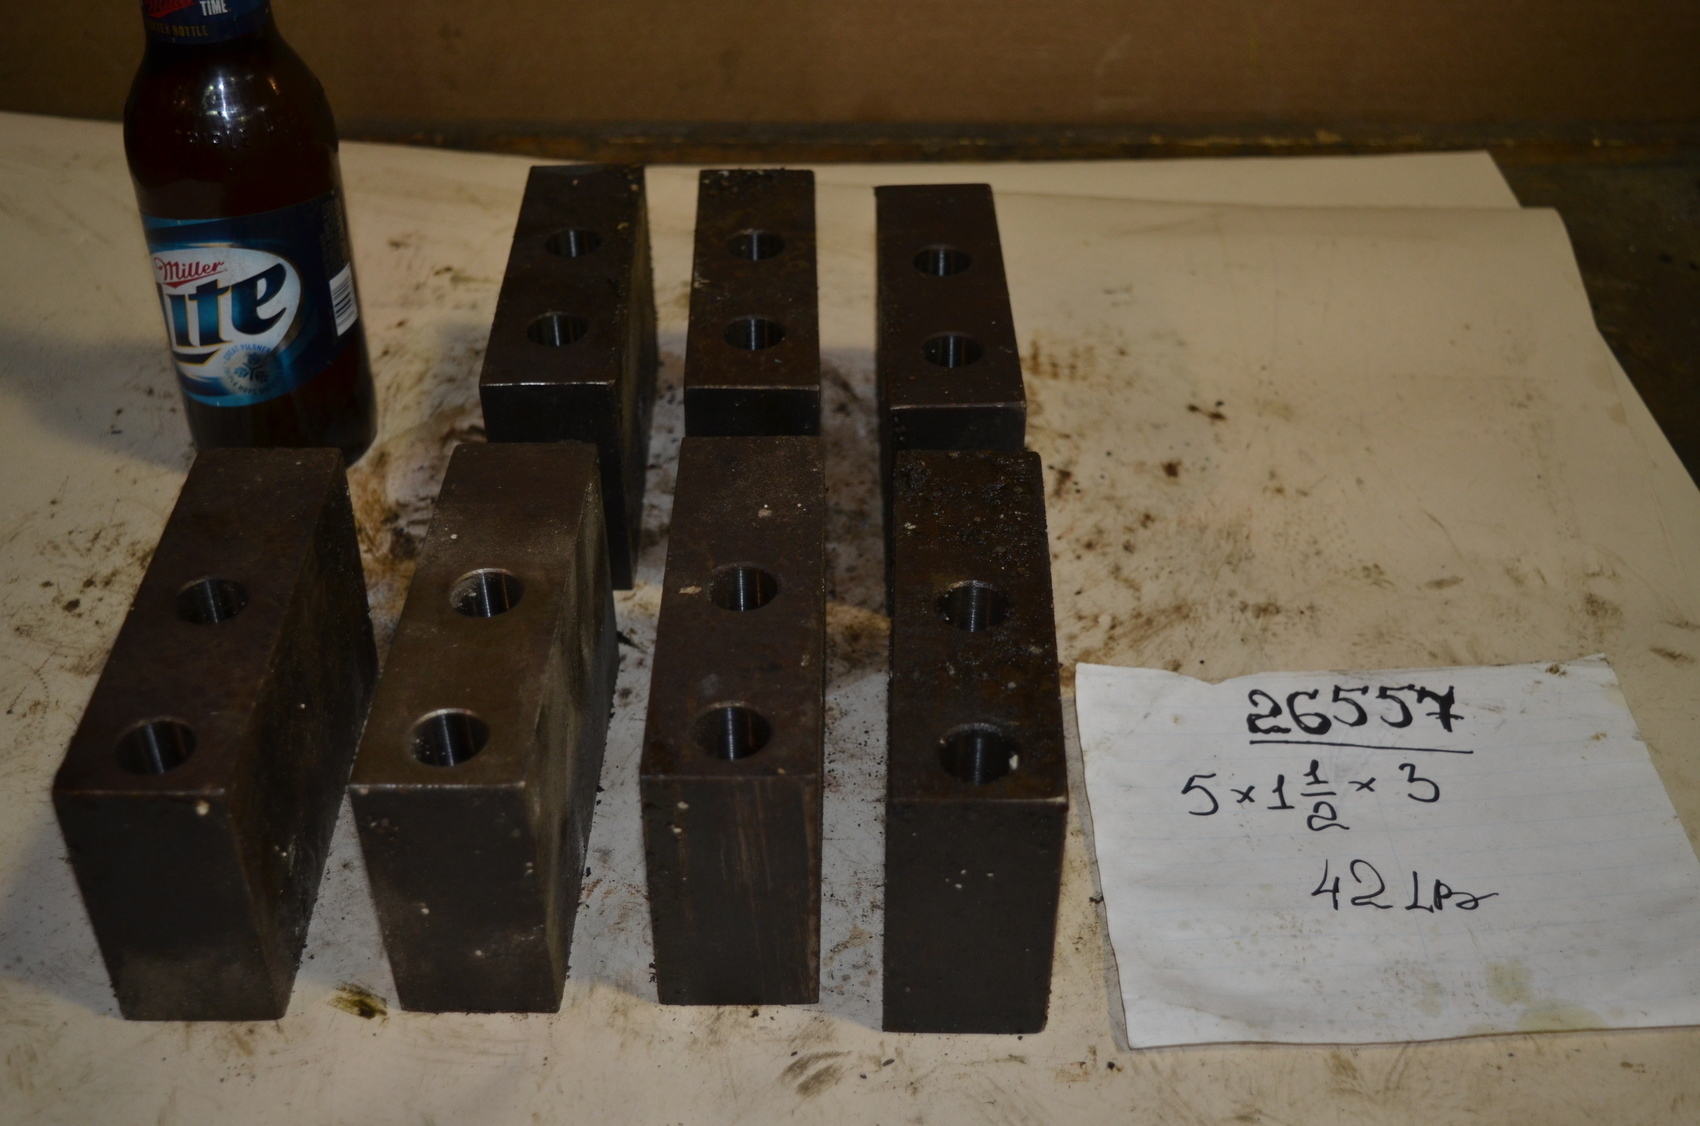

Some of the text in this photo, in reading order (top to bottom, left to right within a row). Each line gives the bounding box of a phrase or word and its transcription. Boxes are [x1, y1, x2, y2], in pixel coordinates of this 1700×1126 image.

[200, 0, 228, 16] TIME
[172, 25, 209, 37] BOTTLE
[154, 256, 225, 282] Miller
[1246, 683, 1465, 736] 26557
[1181, 773, 1219, 816] 5
[1398, 762, 1441, 803] 3
[1310, 858, 1394, 911] 42
